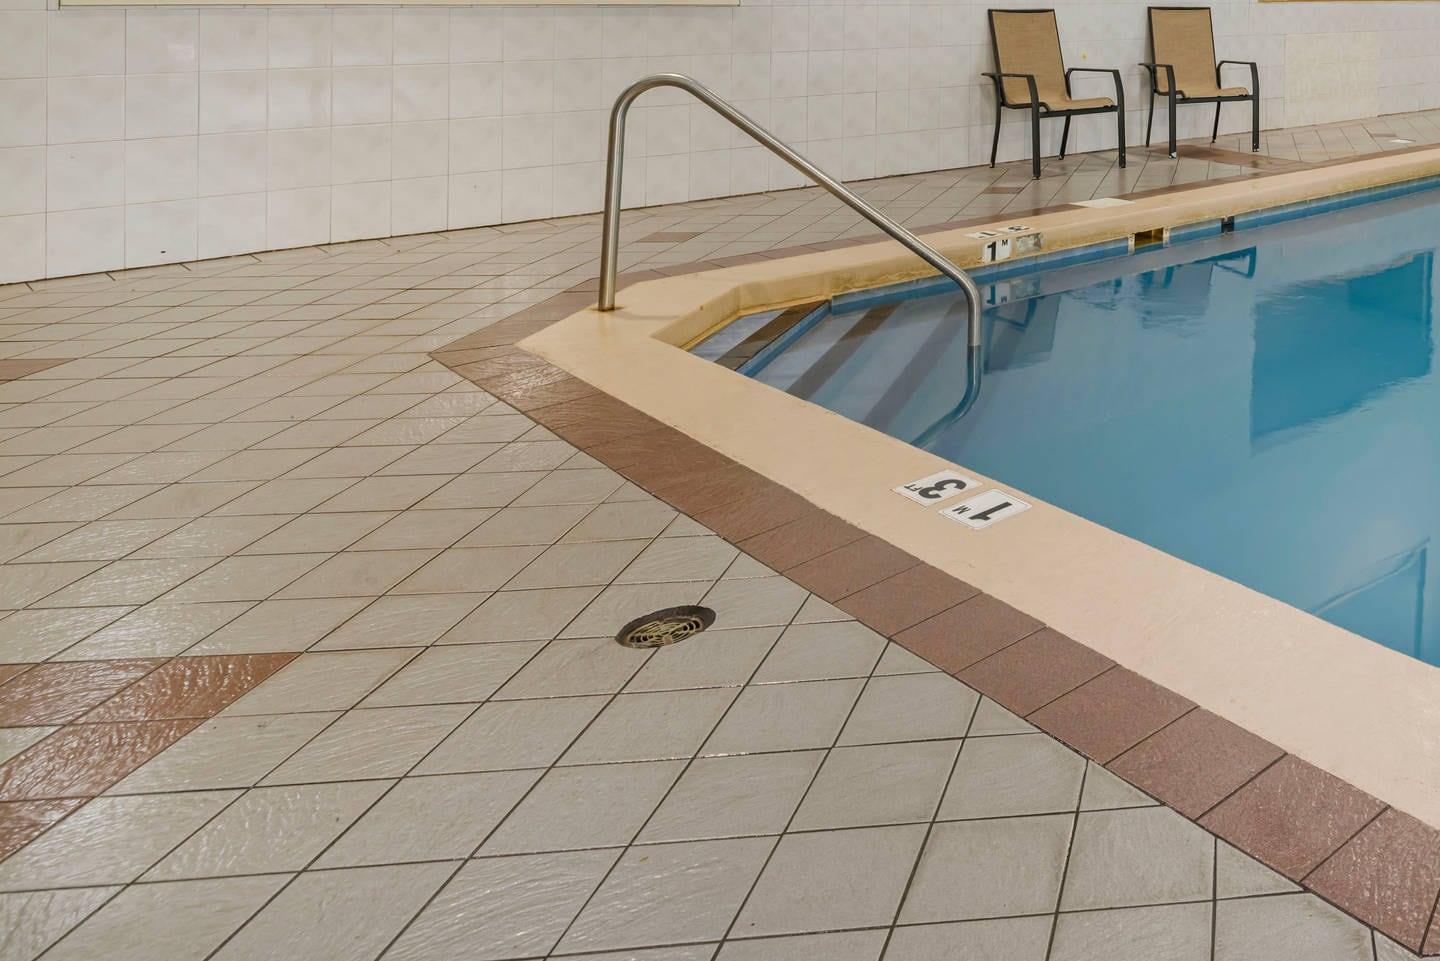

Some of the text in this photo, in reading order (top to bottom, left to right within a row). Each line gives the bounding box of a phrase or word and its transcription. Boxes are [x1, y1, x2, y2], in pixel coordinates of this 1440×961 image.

[987, 241, 997, 262] 1
[918, 478, 967, 500] 3
[951, 501, 1013, 522] 1 M
